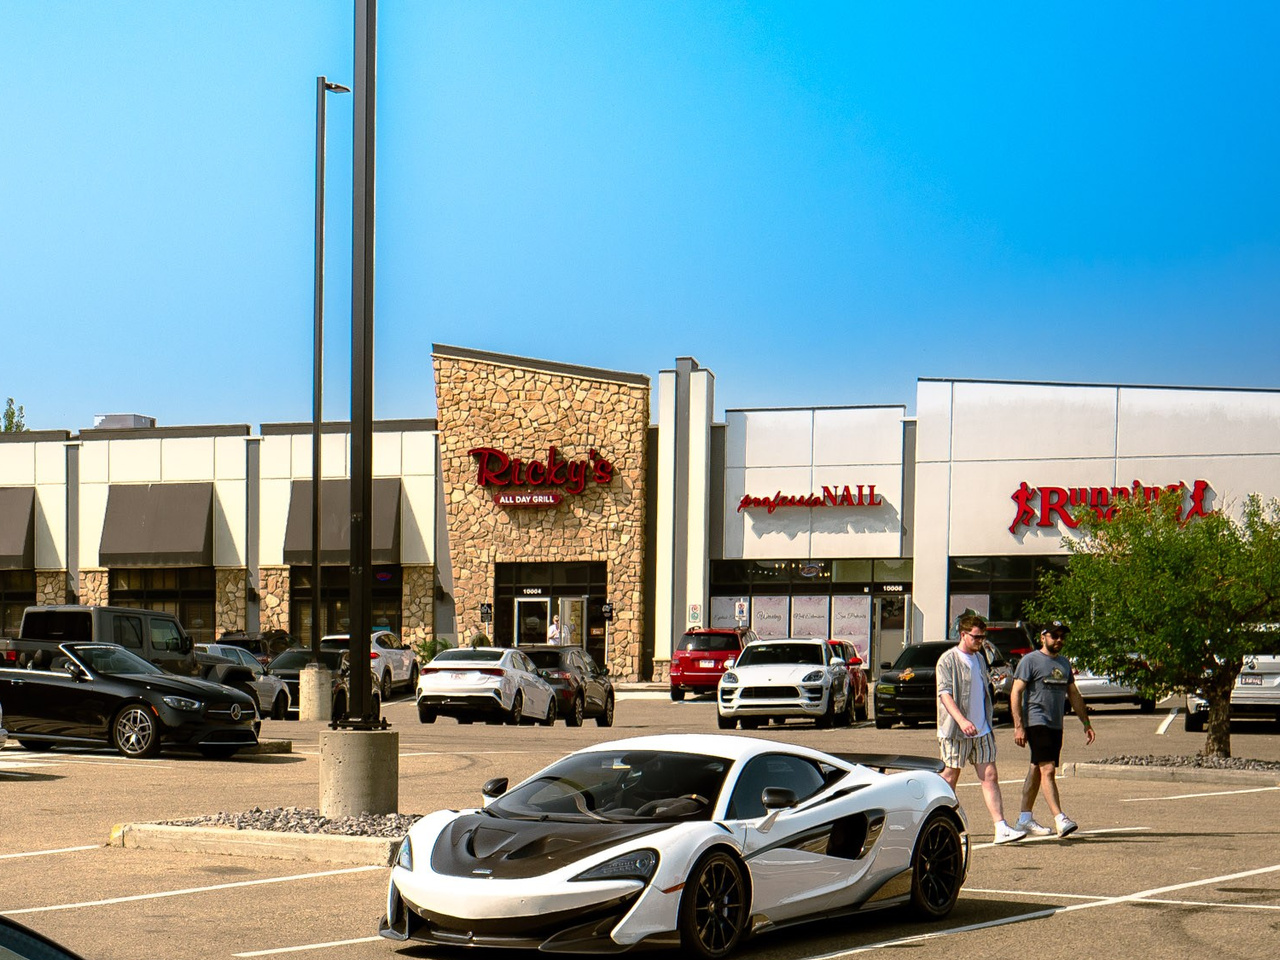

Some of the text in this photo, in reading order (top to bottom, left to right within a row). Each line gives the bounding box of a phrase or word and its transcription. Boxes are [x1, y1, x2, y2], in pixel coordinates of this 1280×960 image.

[468, 446, 612, 494] Ricky's
[532, 495, 554, 503] GRILL
[737, 485, 882, 514] professioNAIL
